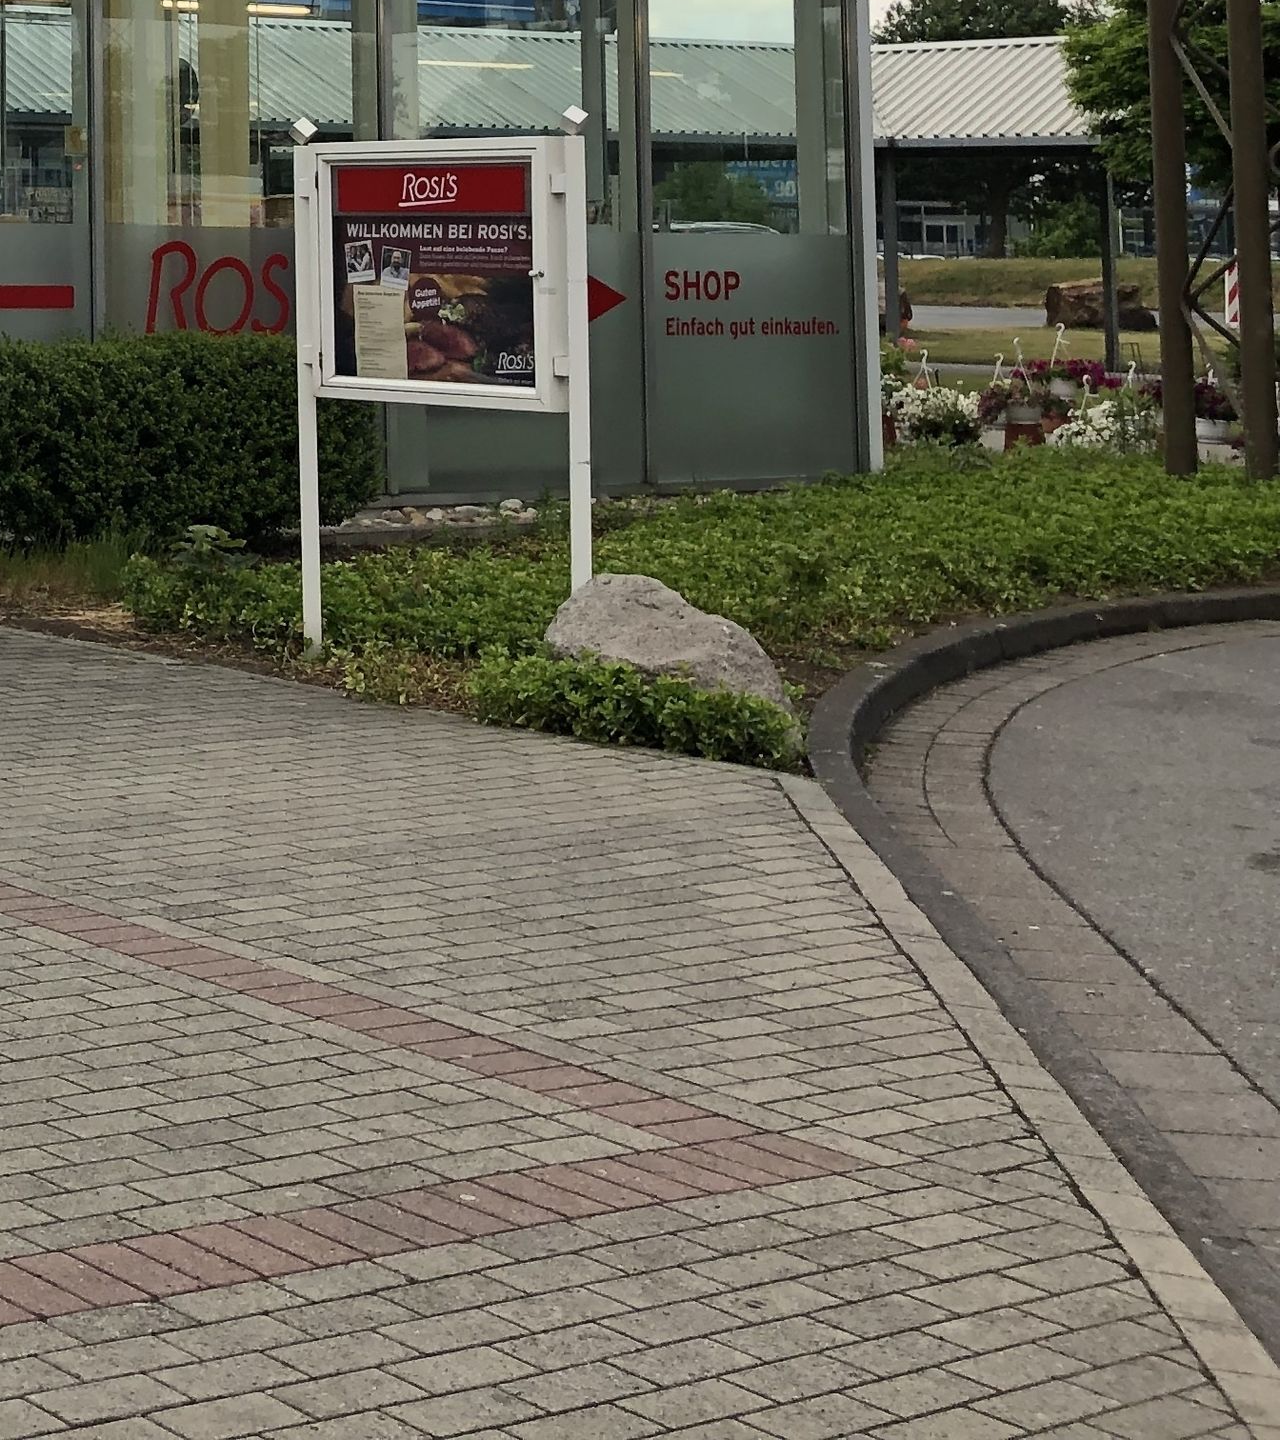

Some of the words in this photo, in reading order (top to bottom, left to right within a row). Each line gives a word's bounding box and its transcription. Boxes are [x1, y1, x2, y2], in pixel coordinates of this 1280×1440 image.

[402, 172, 458, 202] ROSI'S
[346, 223, 443, 239] WILLKOMMEN
[448, 224, 472, 240] BEI
[478, 224, 532, 240] ROSI'S.
[145, 240, 290, 336] ROS
[415, 289, 437, 298] Guten
[665, 270, 740, 301] SHOP
[412, 297, 441, 309] Appetit!
[665, 317, 724, 337] Einfach
[730, 320, 755, 340] gut
[761, 317, 840, 336] einkaufen.
[498, 352, 535, 370] ROSI'S
